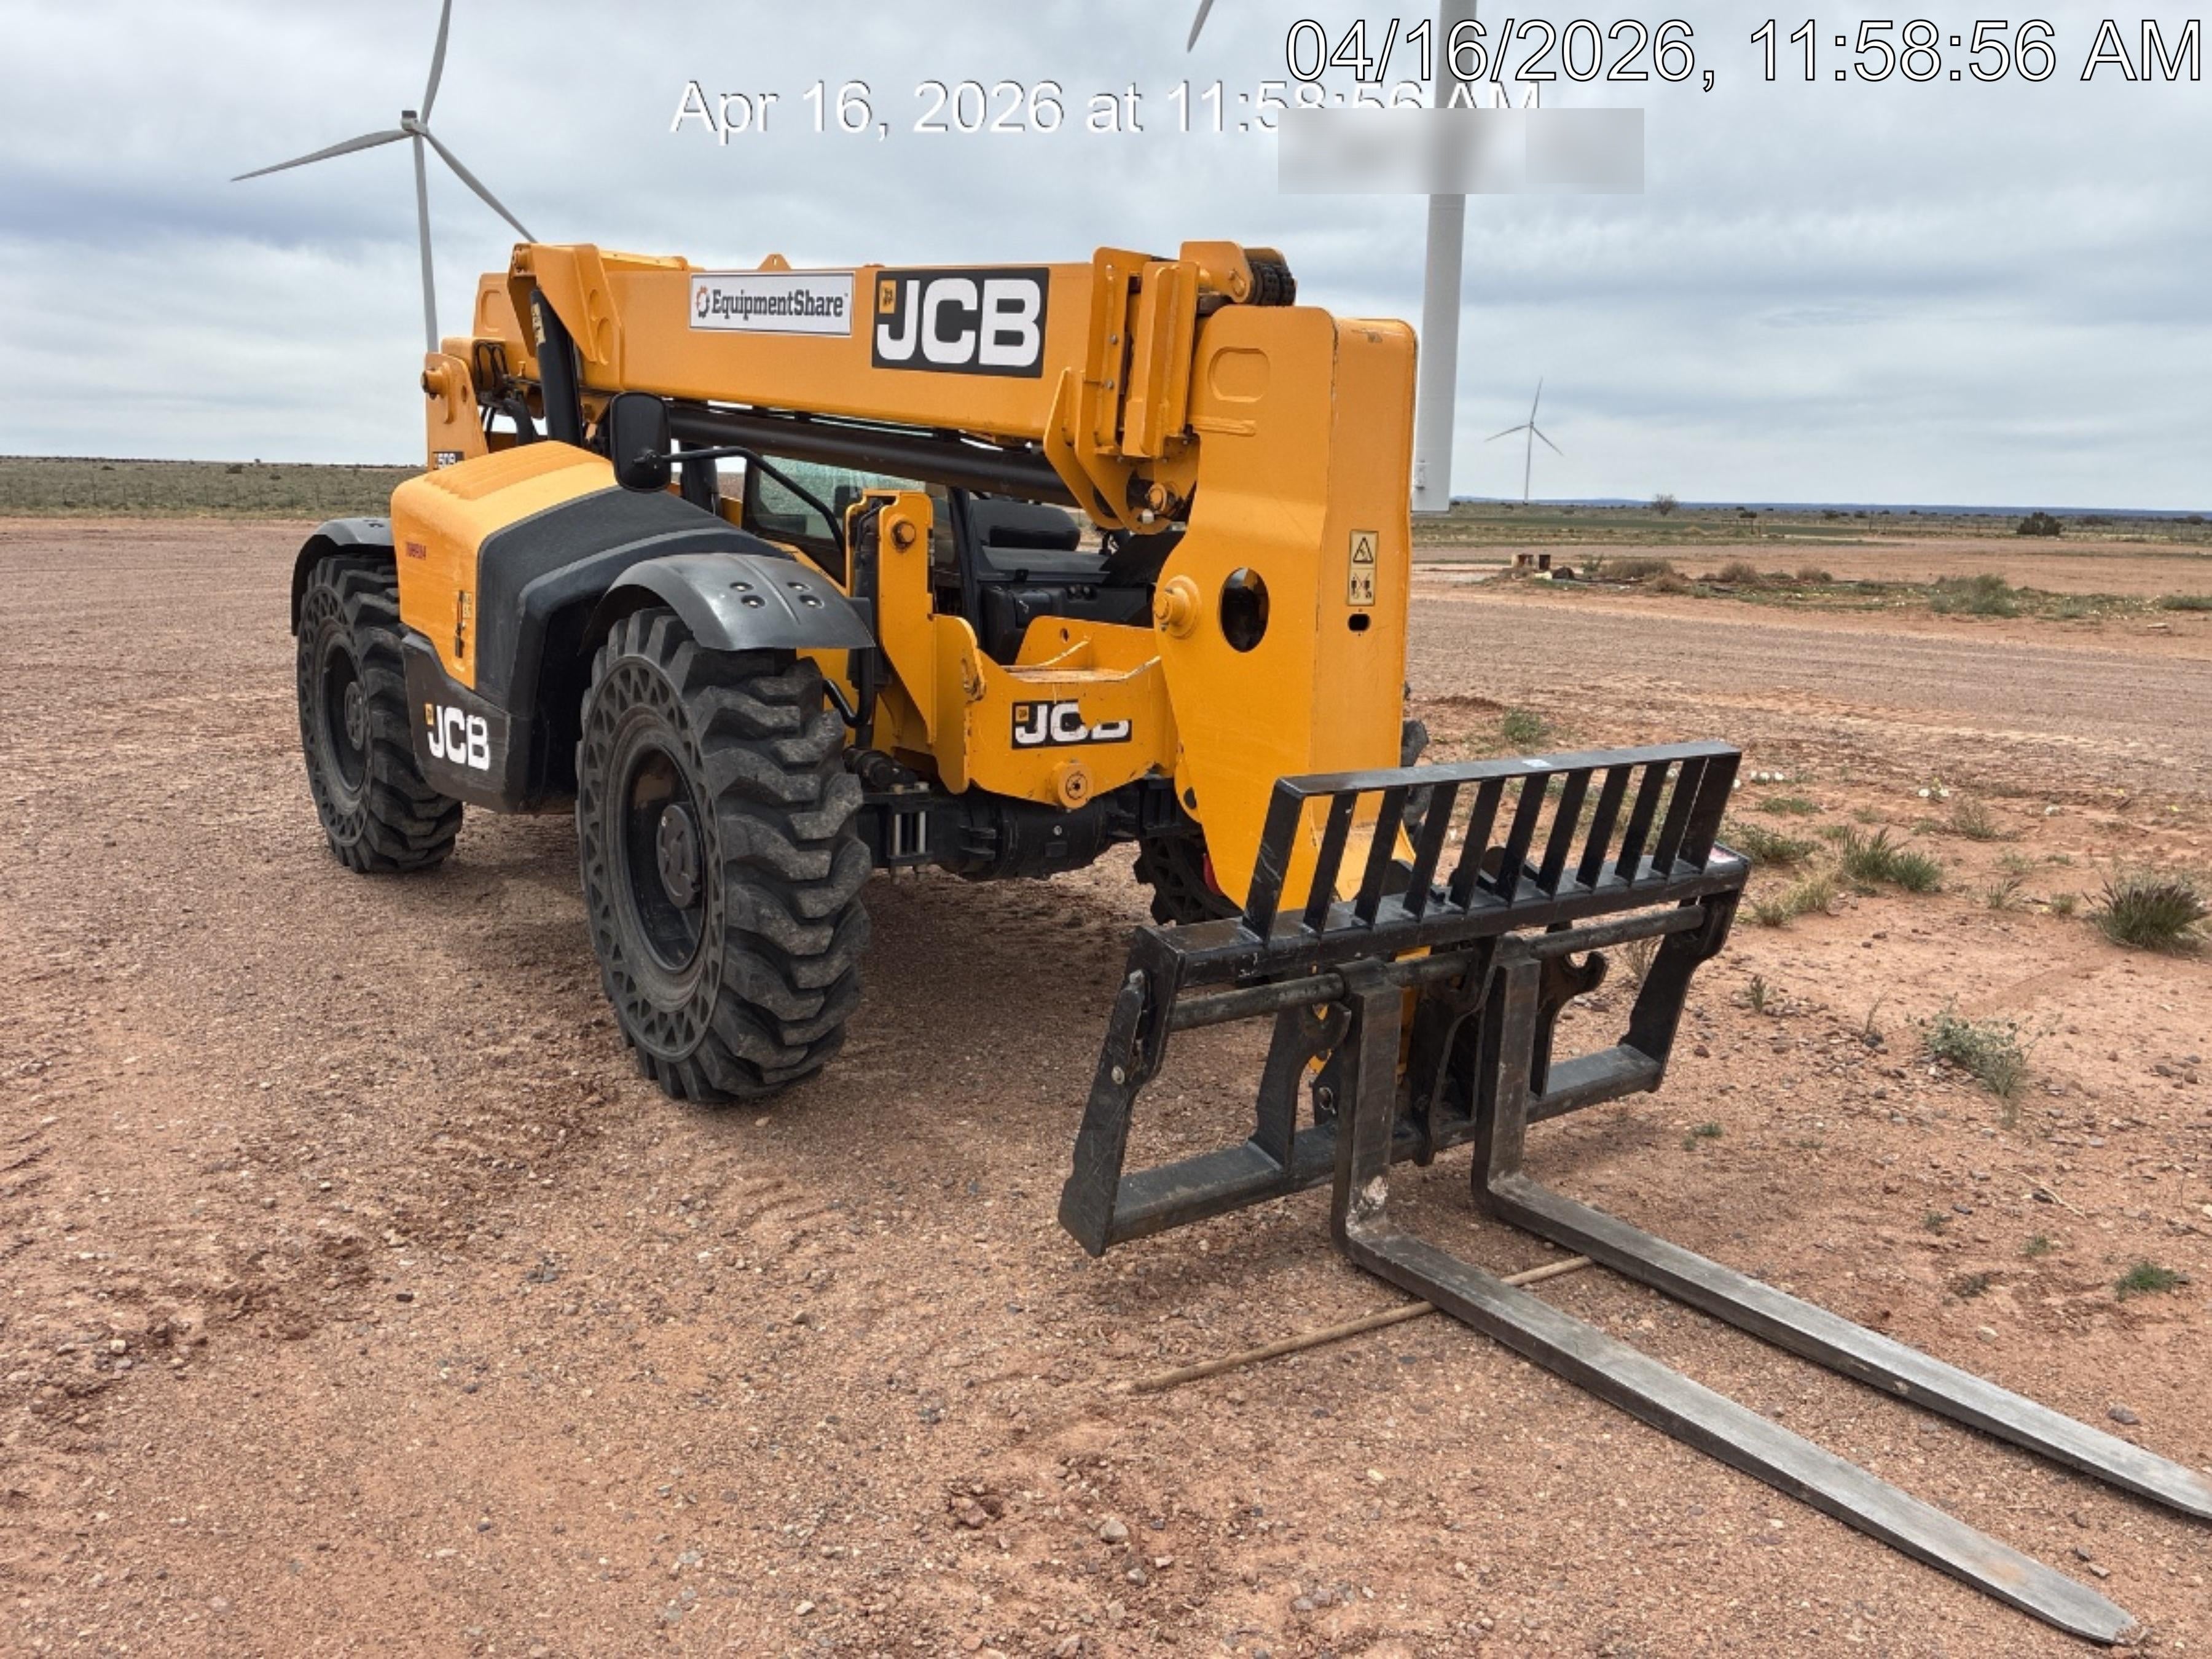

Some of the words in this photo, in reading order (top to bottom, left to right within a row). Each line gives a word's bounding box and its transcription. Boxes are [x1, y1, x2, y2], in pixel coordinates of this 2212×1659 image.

[711, 288, 844, 321] EquipmentShare
[877, 278, 1040, 367] JCB
[427, 705, 490, 772] JCB
